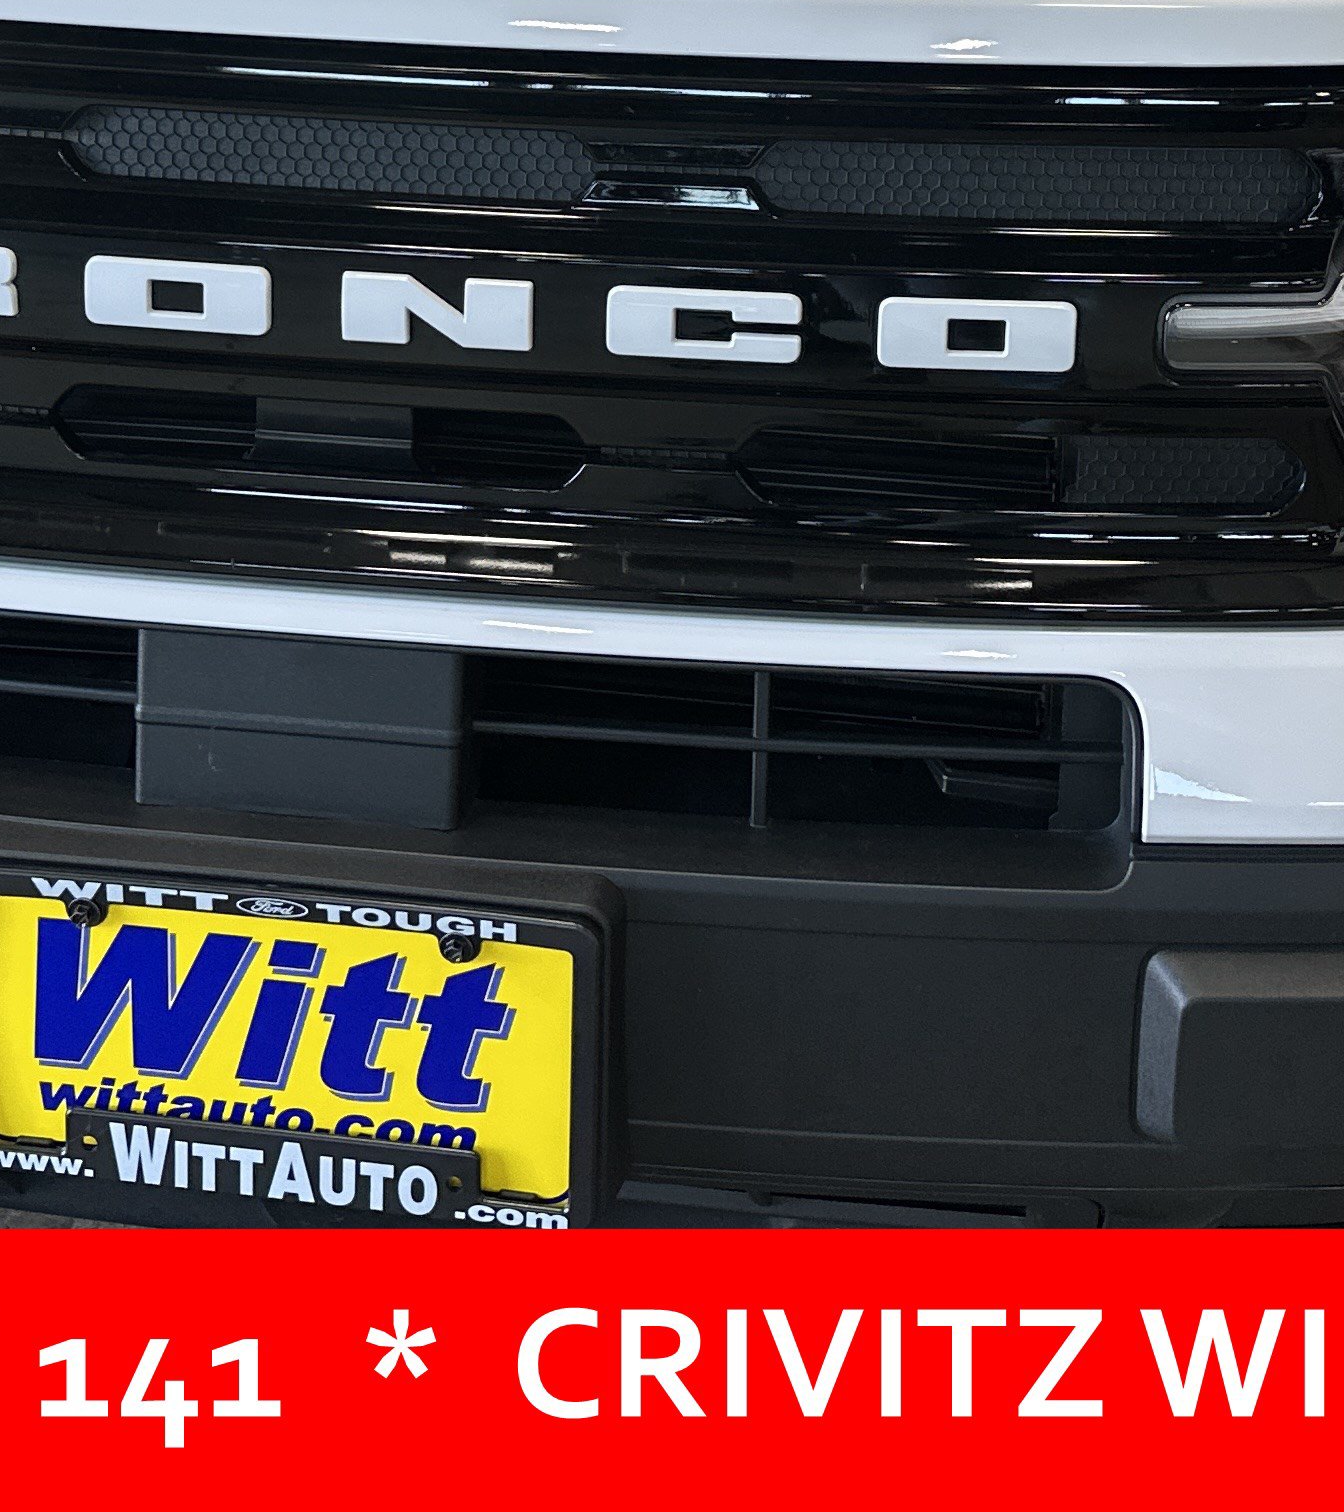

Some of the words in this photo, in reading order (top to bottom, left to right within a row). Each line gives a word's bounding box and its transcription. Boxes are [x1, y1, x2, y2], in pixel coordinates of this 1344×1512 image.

[30, 876, 229, 912] WITT
[248, 898, 296, 917] Ford
[314, 902, 518, 943] TOUGH
[33, 916, 516, 1113] Witt
[454, 1202, 569, 1230] .com
